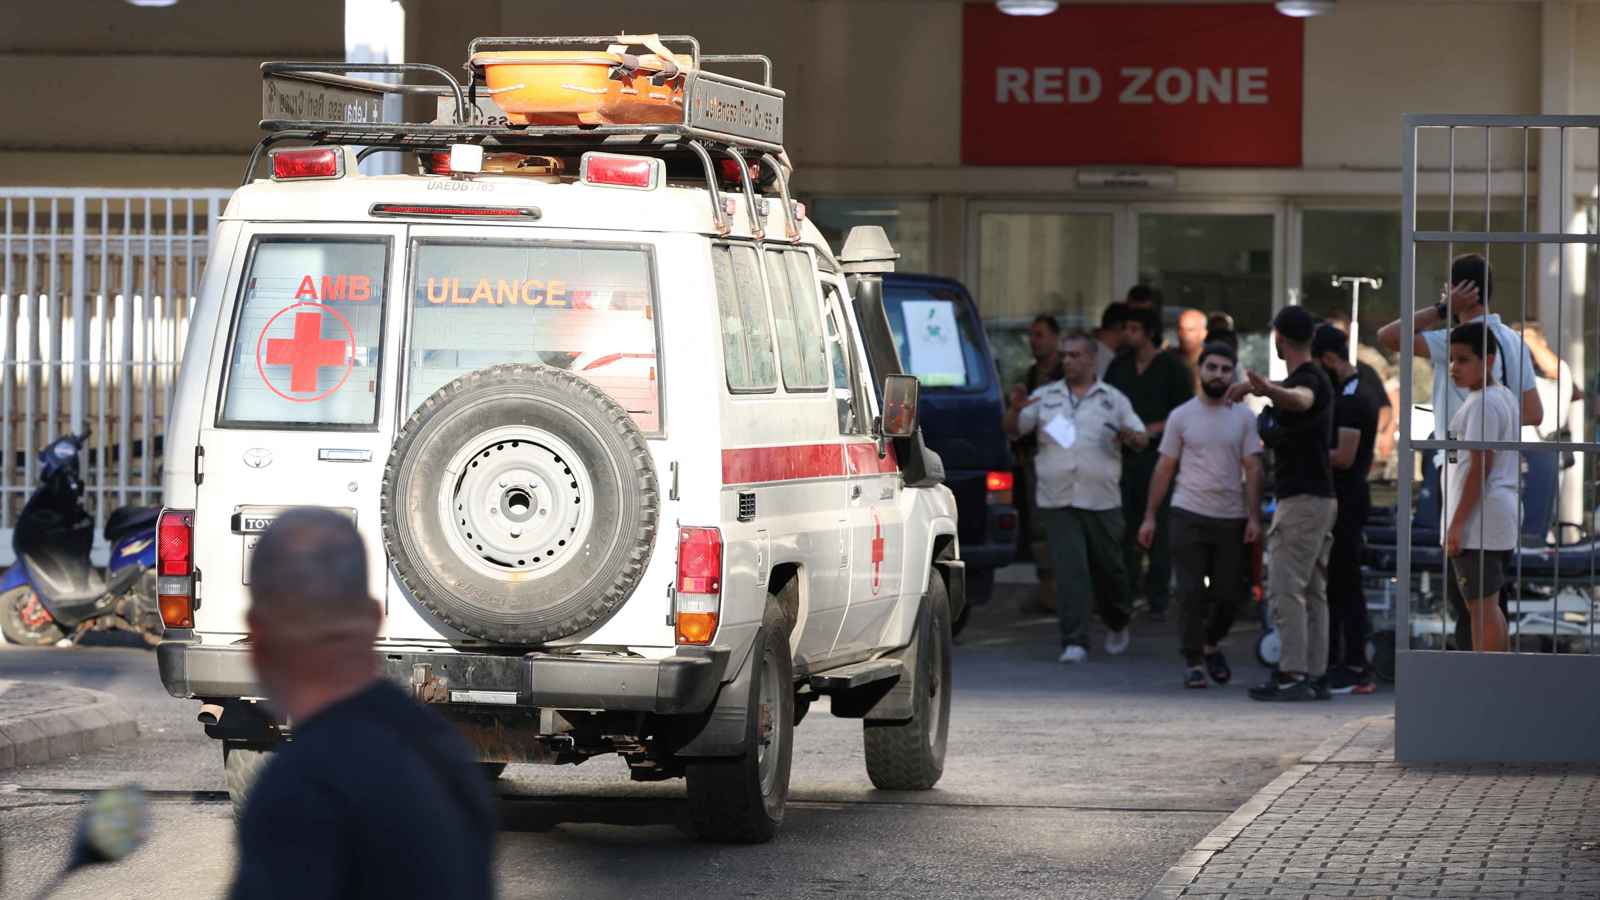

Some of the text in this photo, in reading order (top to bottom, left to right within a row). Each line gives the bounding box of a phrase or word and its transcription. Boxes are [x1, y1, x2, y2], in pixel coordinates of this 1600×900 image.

[996, 67, 1268, 104] RED ZONE
[295, 275, 567, 307] AMB ULANCE
[247, 519, 273, 529] TOY
